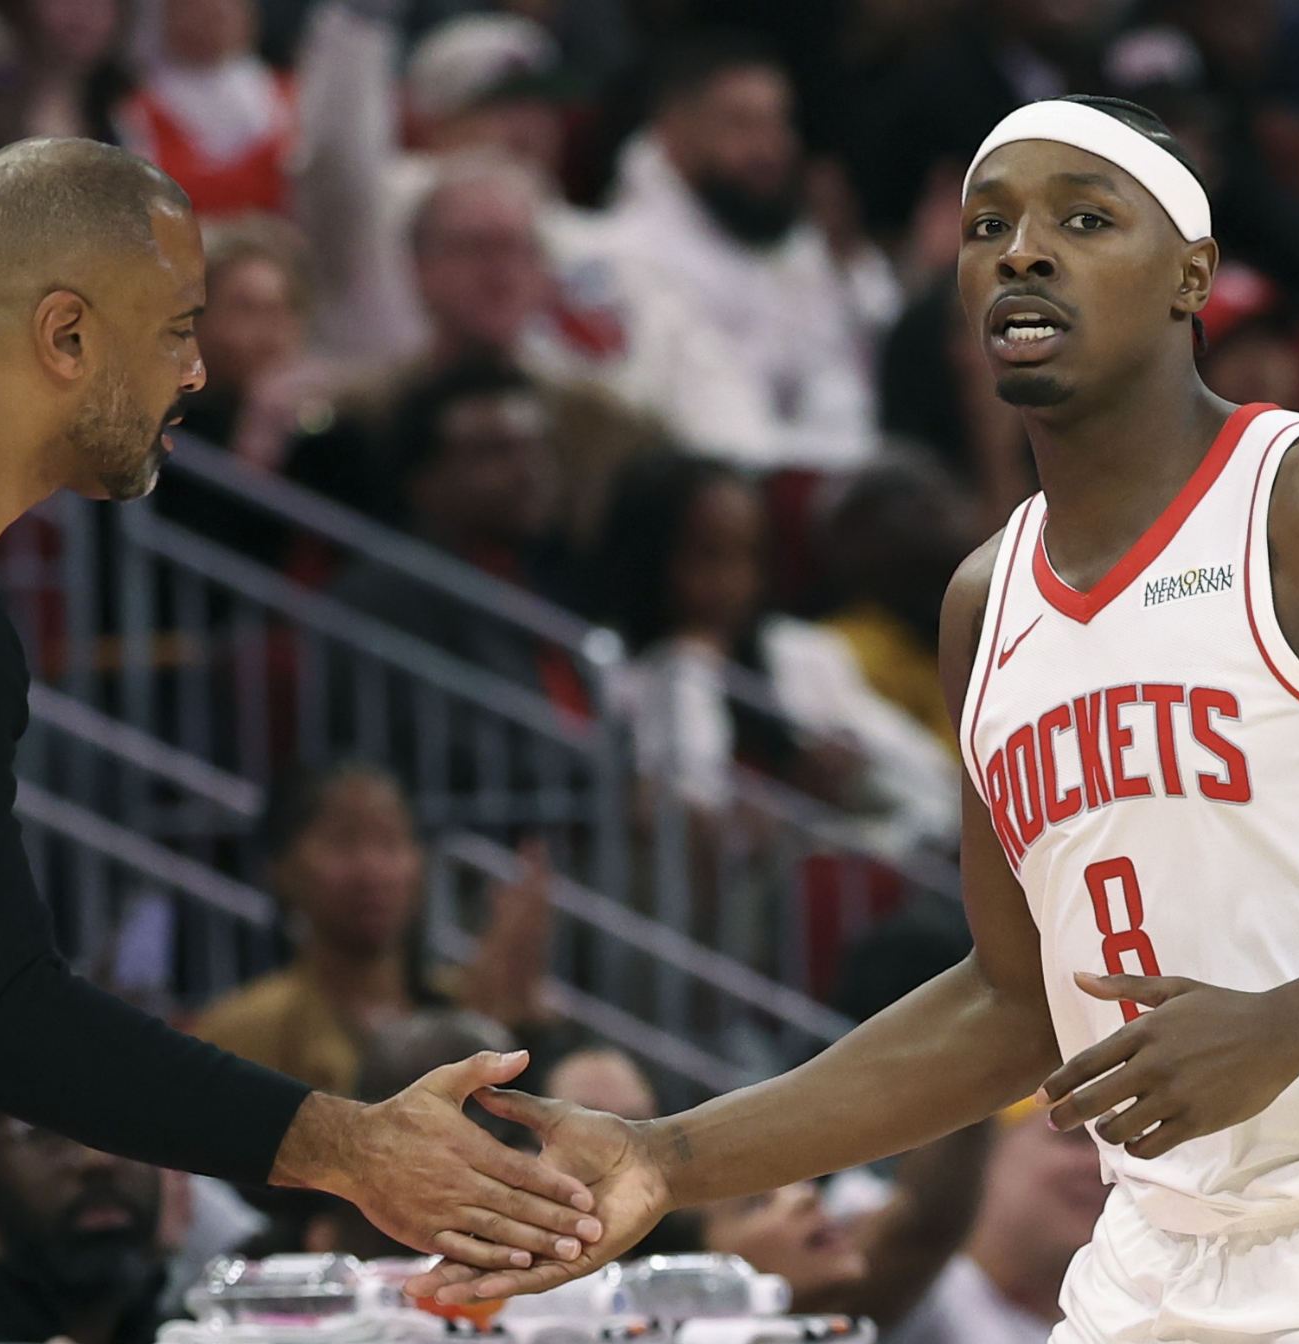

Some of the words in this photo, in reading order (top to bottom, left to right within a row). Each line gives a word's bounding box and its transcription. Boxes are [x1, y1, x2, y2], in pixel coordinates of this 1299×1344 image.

[1143, 576, 1233, 607] HERMANN
[1144, 564, 1235, 596] MEMORIAL
[986, 683, 1252, 877] ROCKETS
[1084, 856, 1161, 1024] 8
